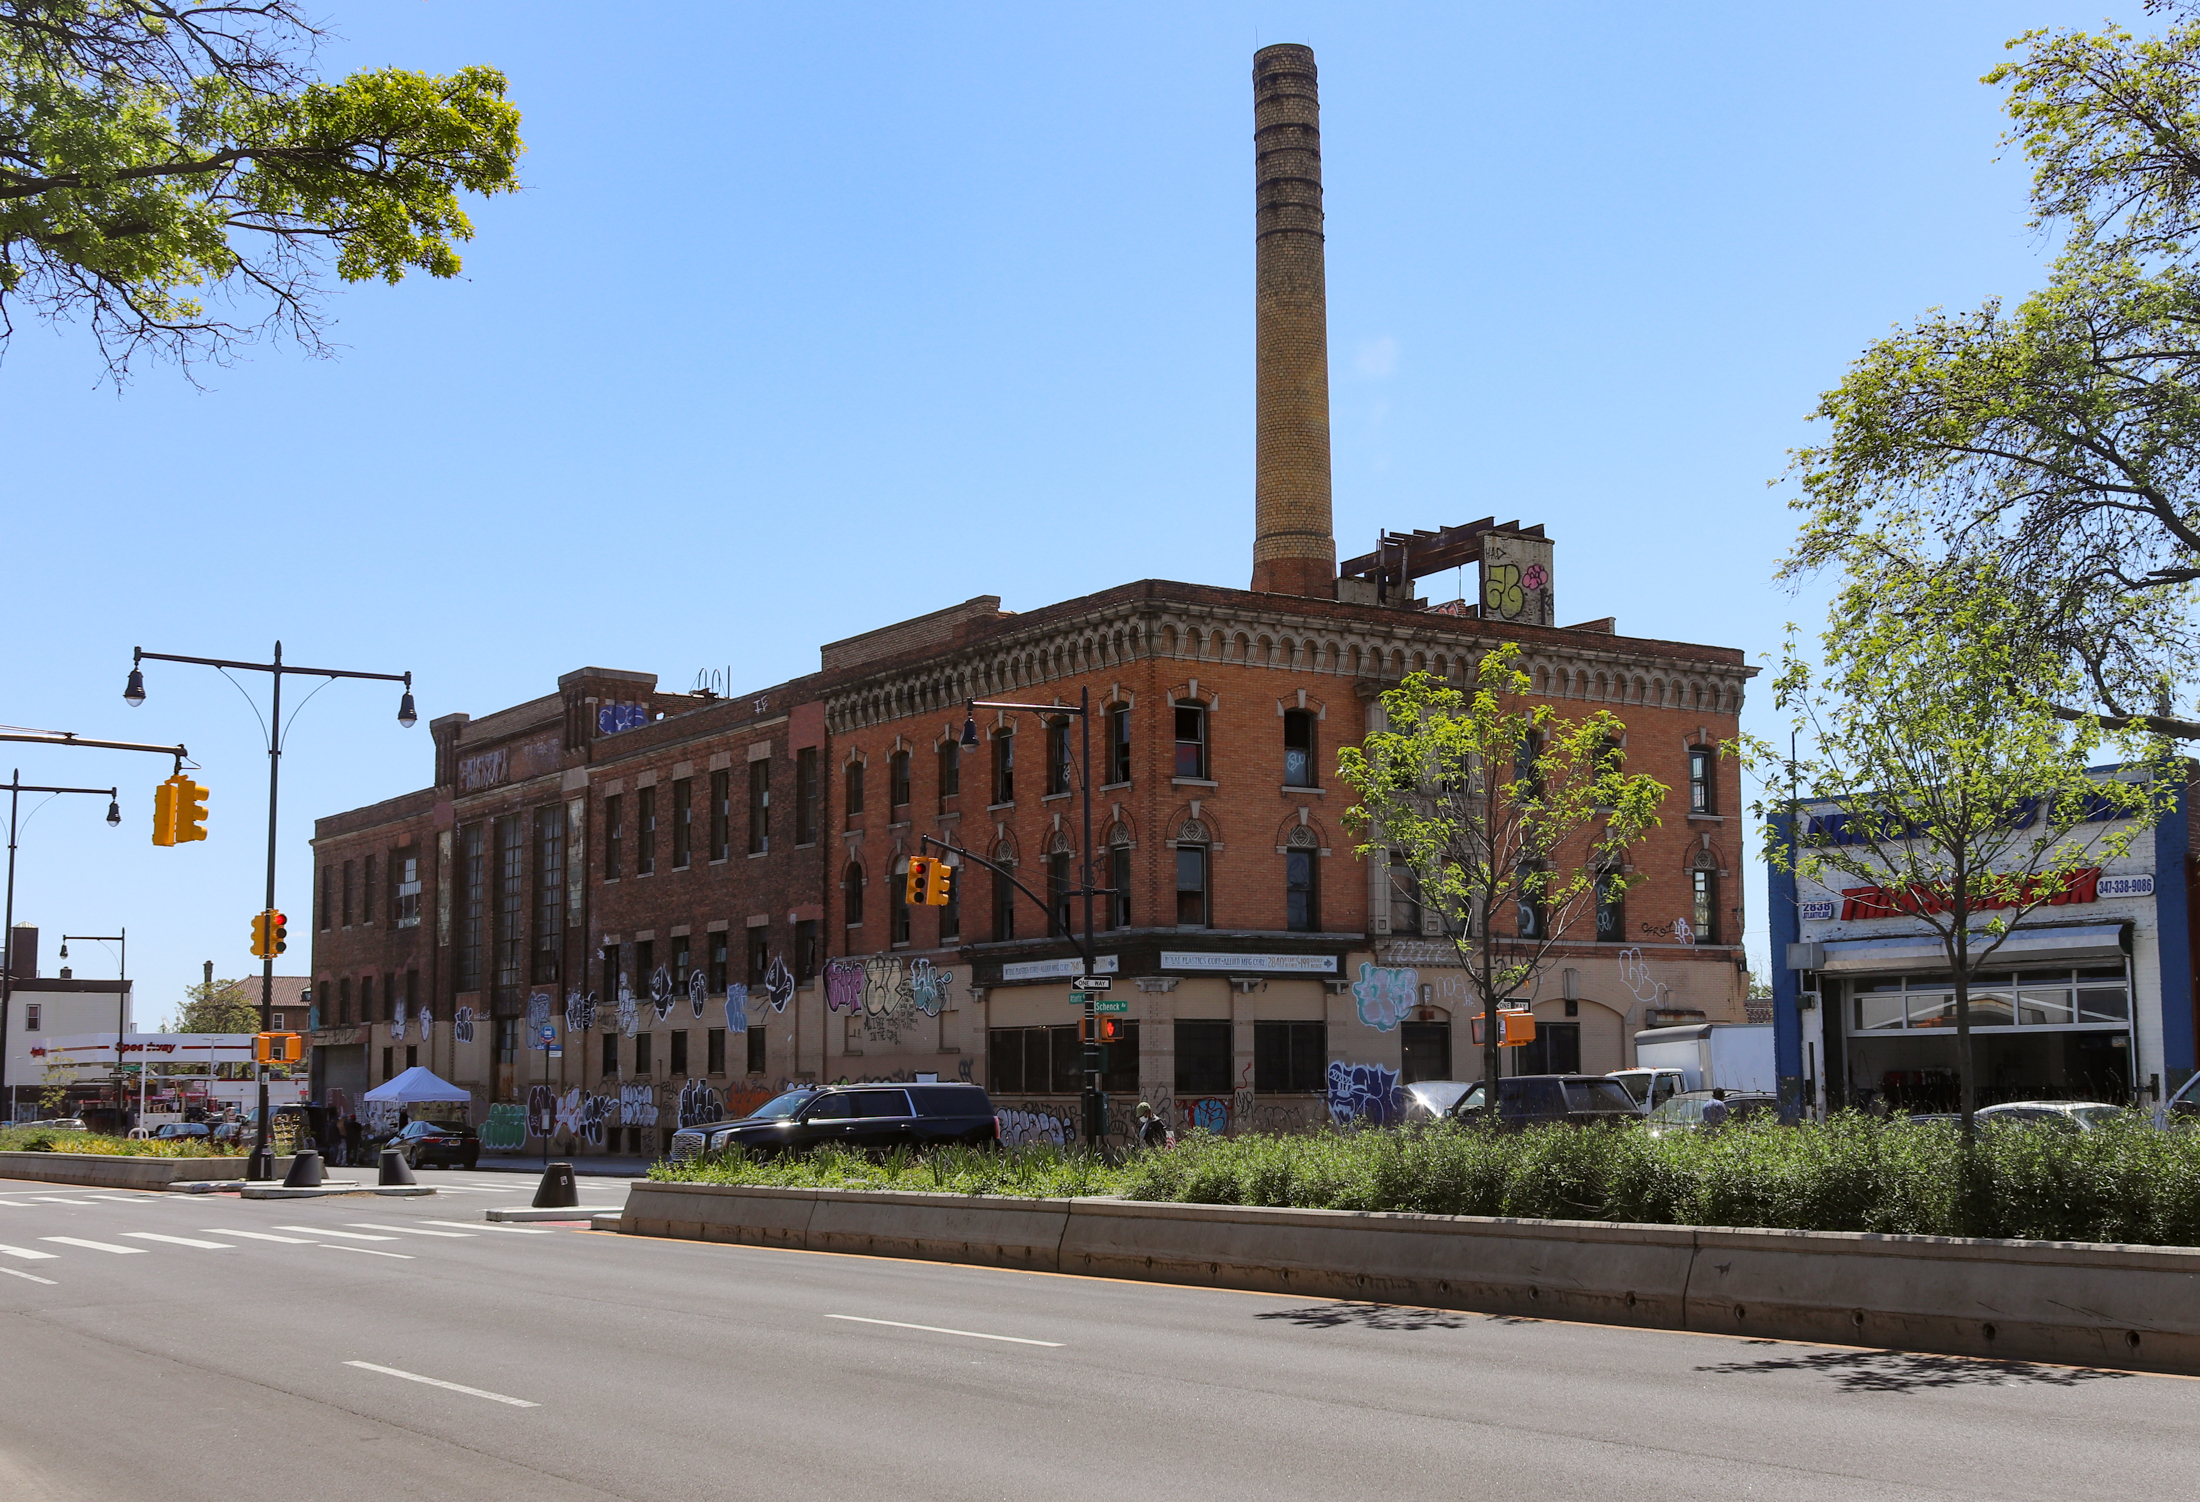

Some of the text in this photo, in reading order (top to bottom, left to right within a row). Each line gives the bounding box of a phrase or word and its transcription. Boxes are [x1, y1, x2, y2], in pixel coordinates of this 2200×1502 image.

[2099, 878, 2152, 894] 347-338-9086
[1840, 867, 2101, 920] TRANSSSION
[1802, 902, 1830, 911] 2838
[1182, 956, 1207, 965] PLASTICS
[1267, 956, 1284, 968] 2840
[1095, 1002, 1120, 1011] Schenck
